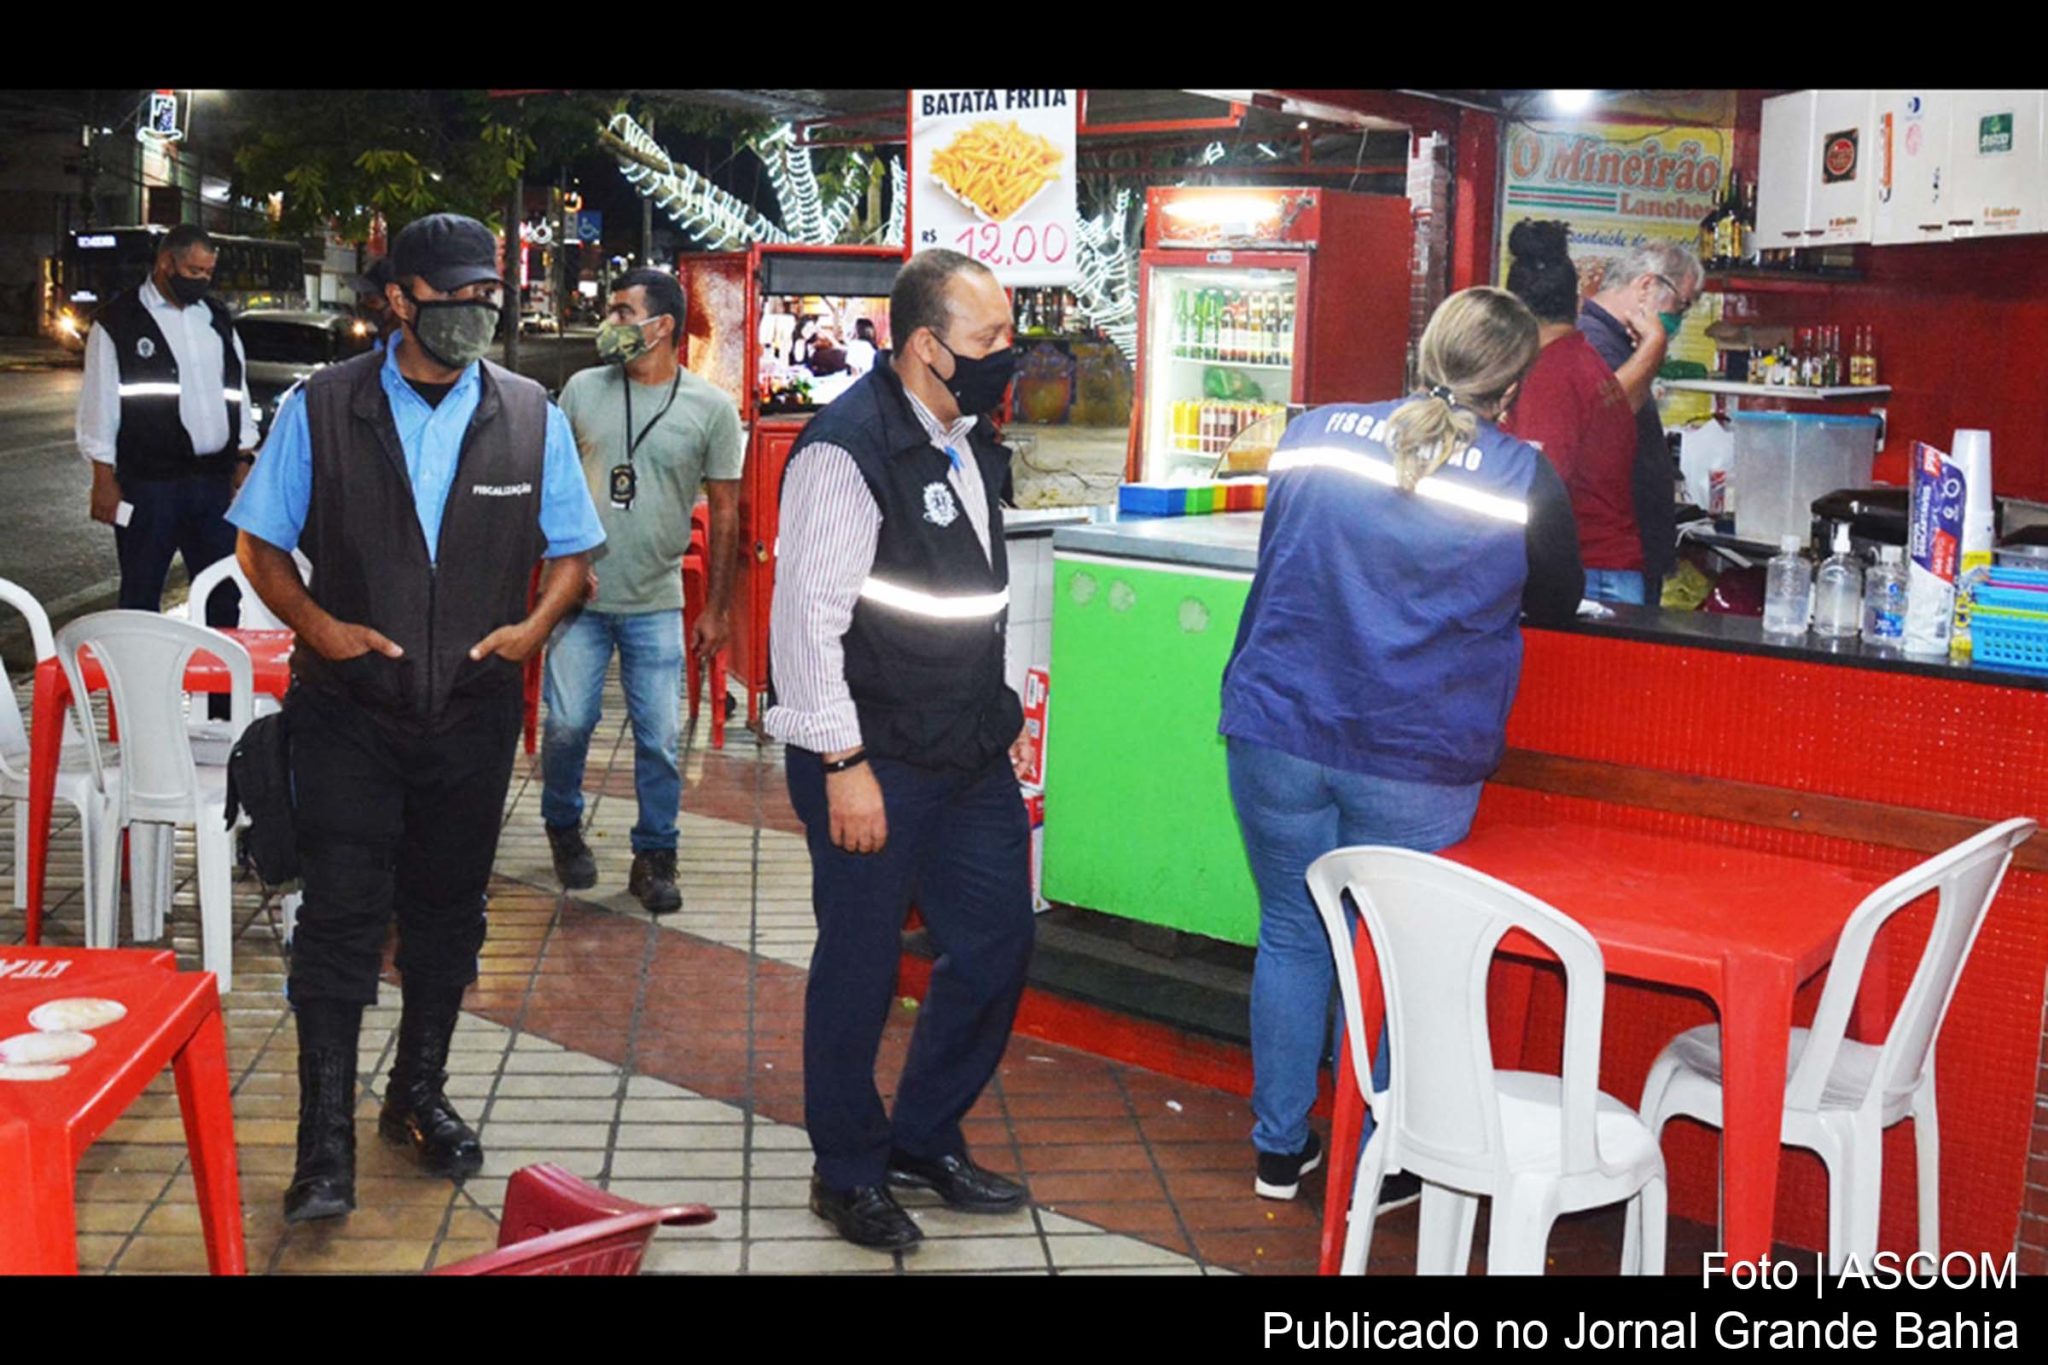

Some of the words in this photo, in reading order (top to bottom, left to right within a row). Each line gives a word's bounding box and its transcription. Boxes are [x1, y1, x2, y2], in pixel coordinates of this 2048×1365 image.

[922, 90, 998, 116] BATATA
[1005, 89, 1067, 110] FRITA
[1510, 131, 1541, 180] O
[1545, 134, 1722, 194] Mineirão
[921, 229, 938, 244] R$
[472, 482, 532, 496] FISCALIZAÇÃO
